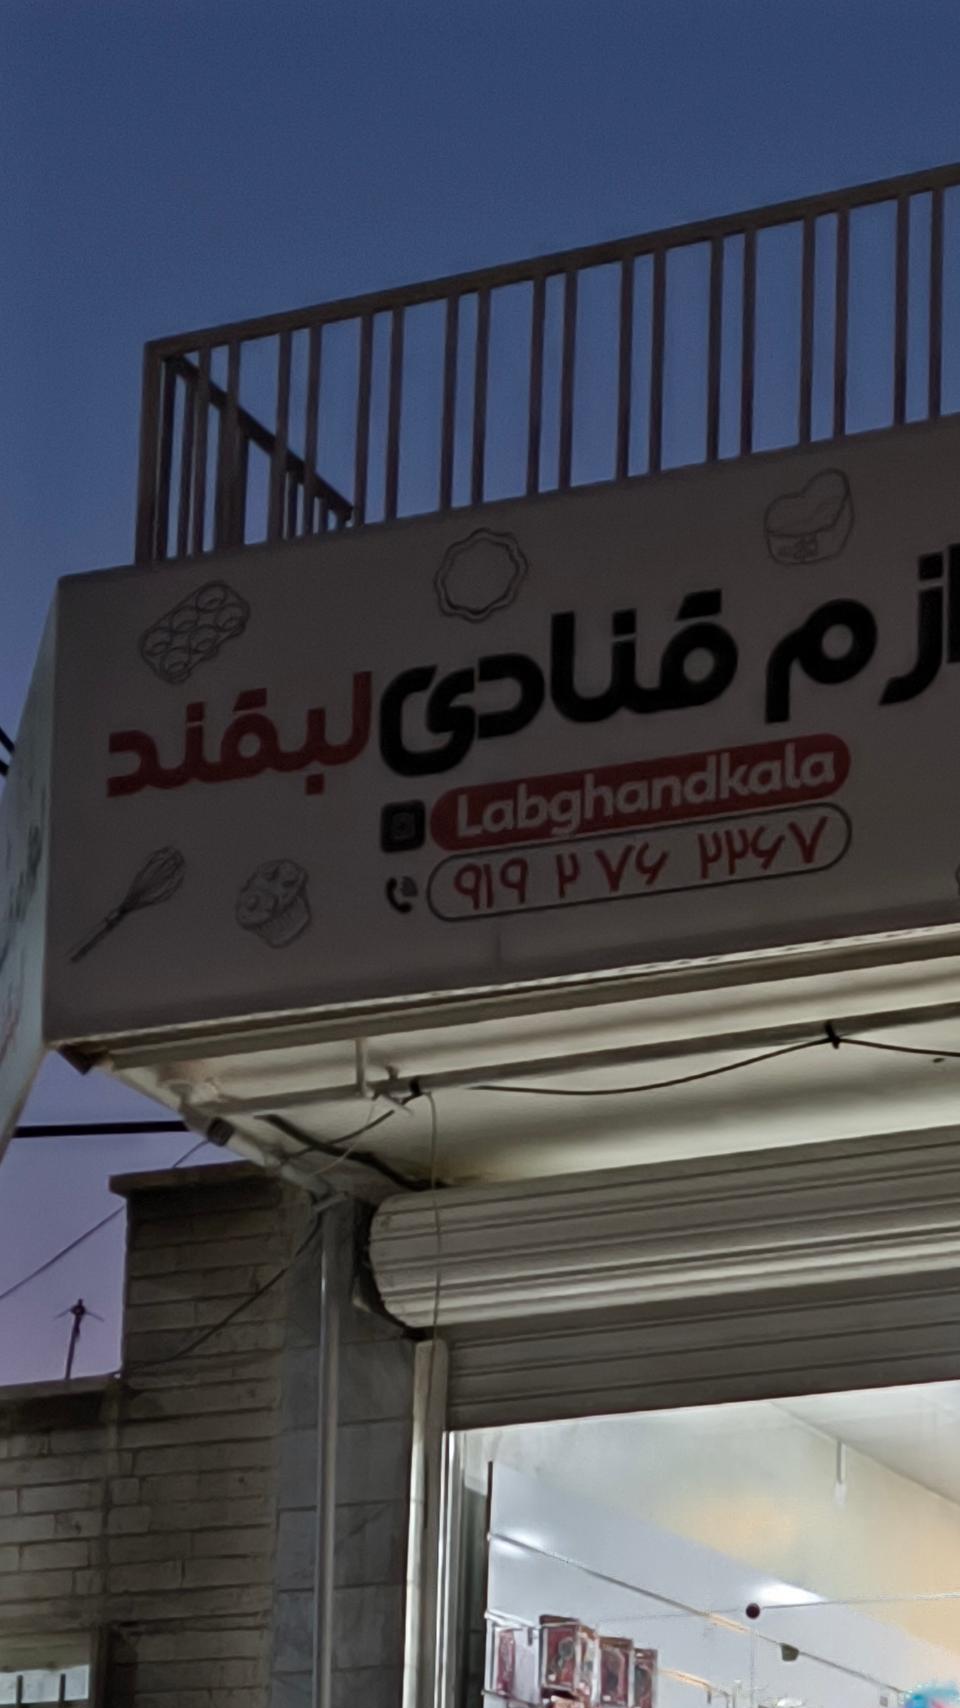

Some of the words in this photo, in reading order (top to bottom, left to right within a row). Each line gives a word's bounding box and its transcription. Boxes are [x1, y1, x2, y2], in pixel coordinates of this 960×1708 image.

[106, 671, 373, 798] لبقند
[378, 588, 740, 778] قنادی
[455, 741, 836, 838] Labghandkala
